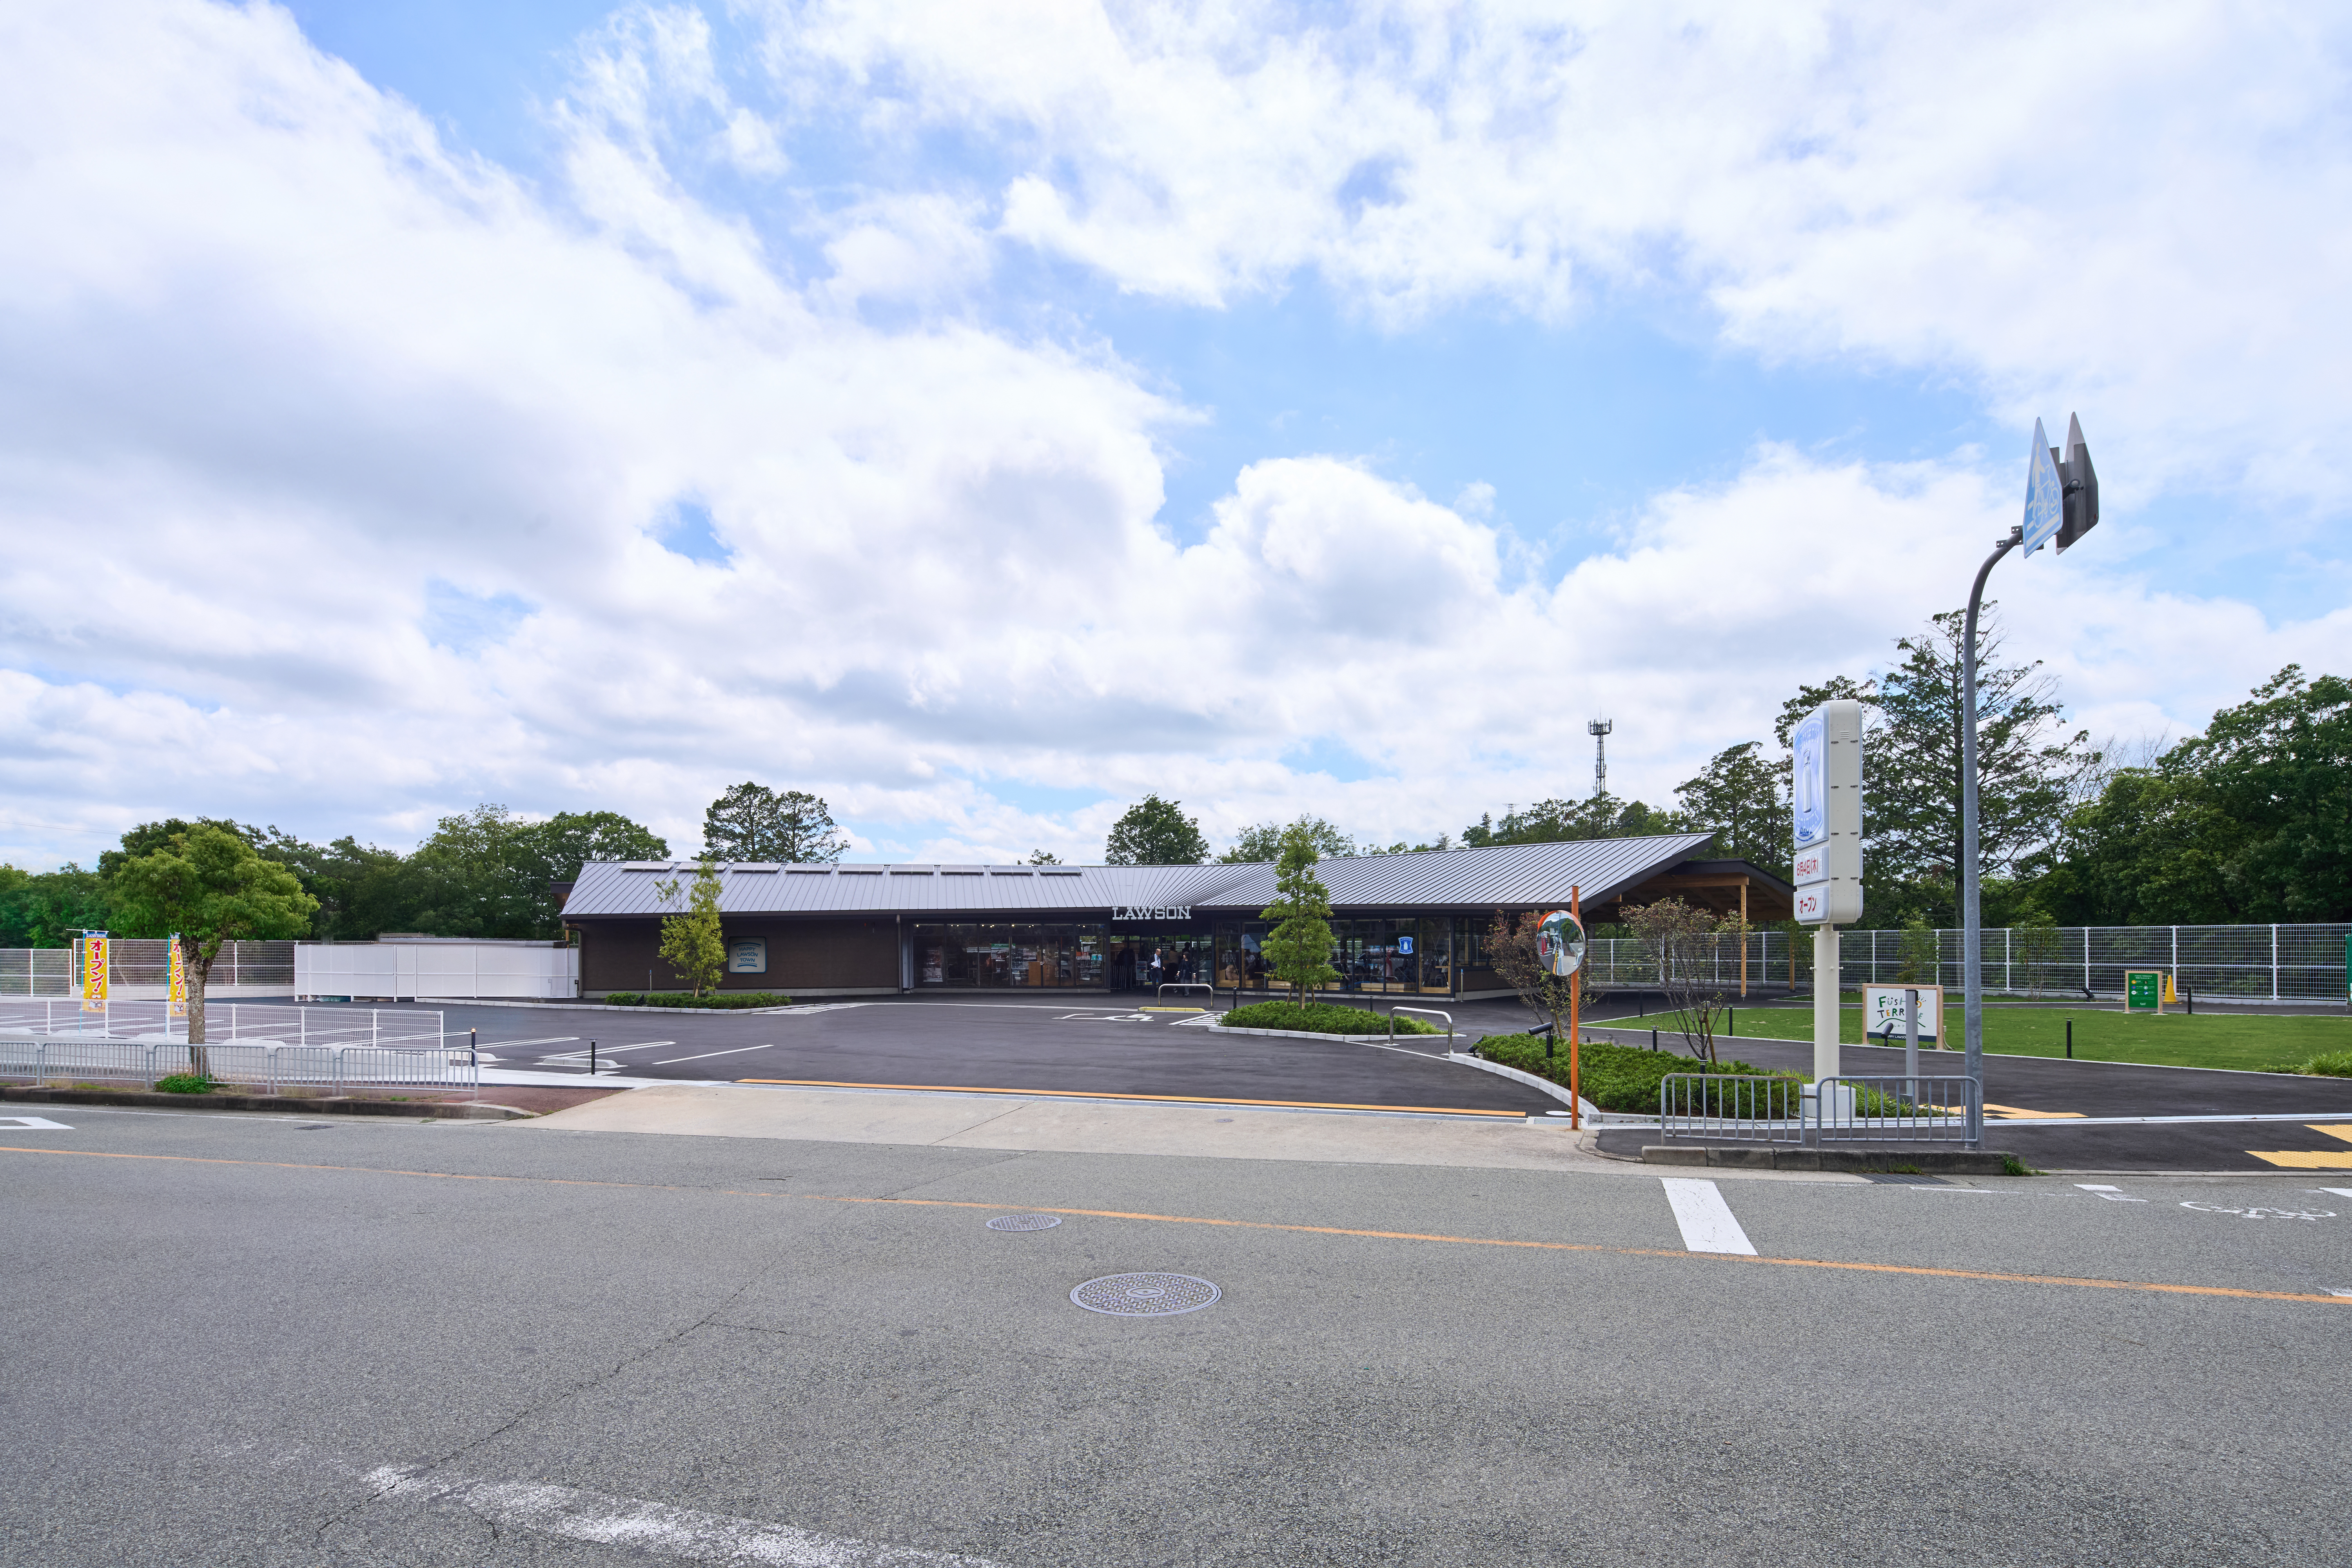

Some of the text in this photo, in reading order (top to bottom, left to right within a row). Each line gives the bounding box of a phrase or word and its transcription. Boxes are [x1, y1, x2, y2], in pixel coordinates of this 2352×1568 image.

[1797, 856, 1818, 877] 6月4日(木)
[1112, 906, 1191, 920] LAWSON
[1799, 895, 1817, 914] オープン
[90, 940, 105, 992] オープン!
[1877, 1008, 1923, 1019] TERRE
